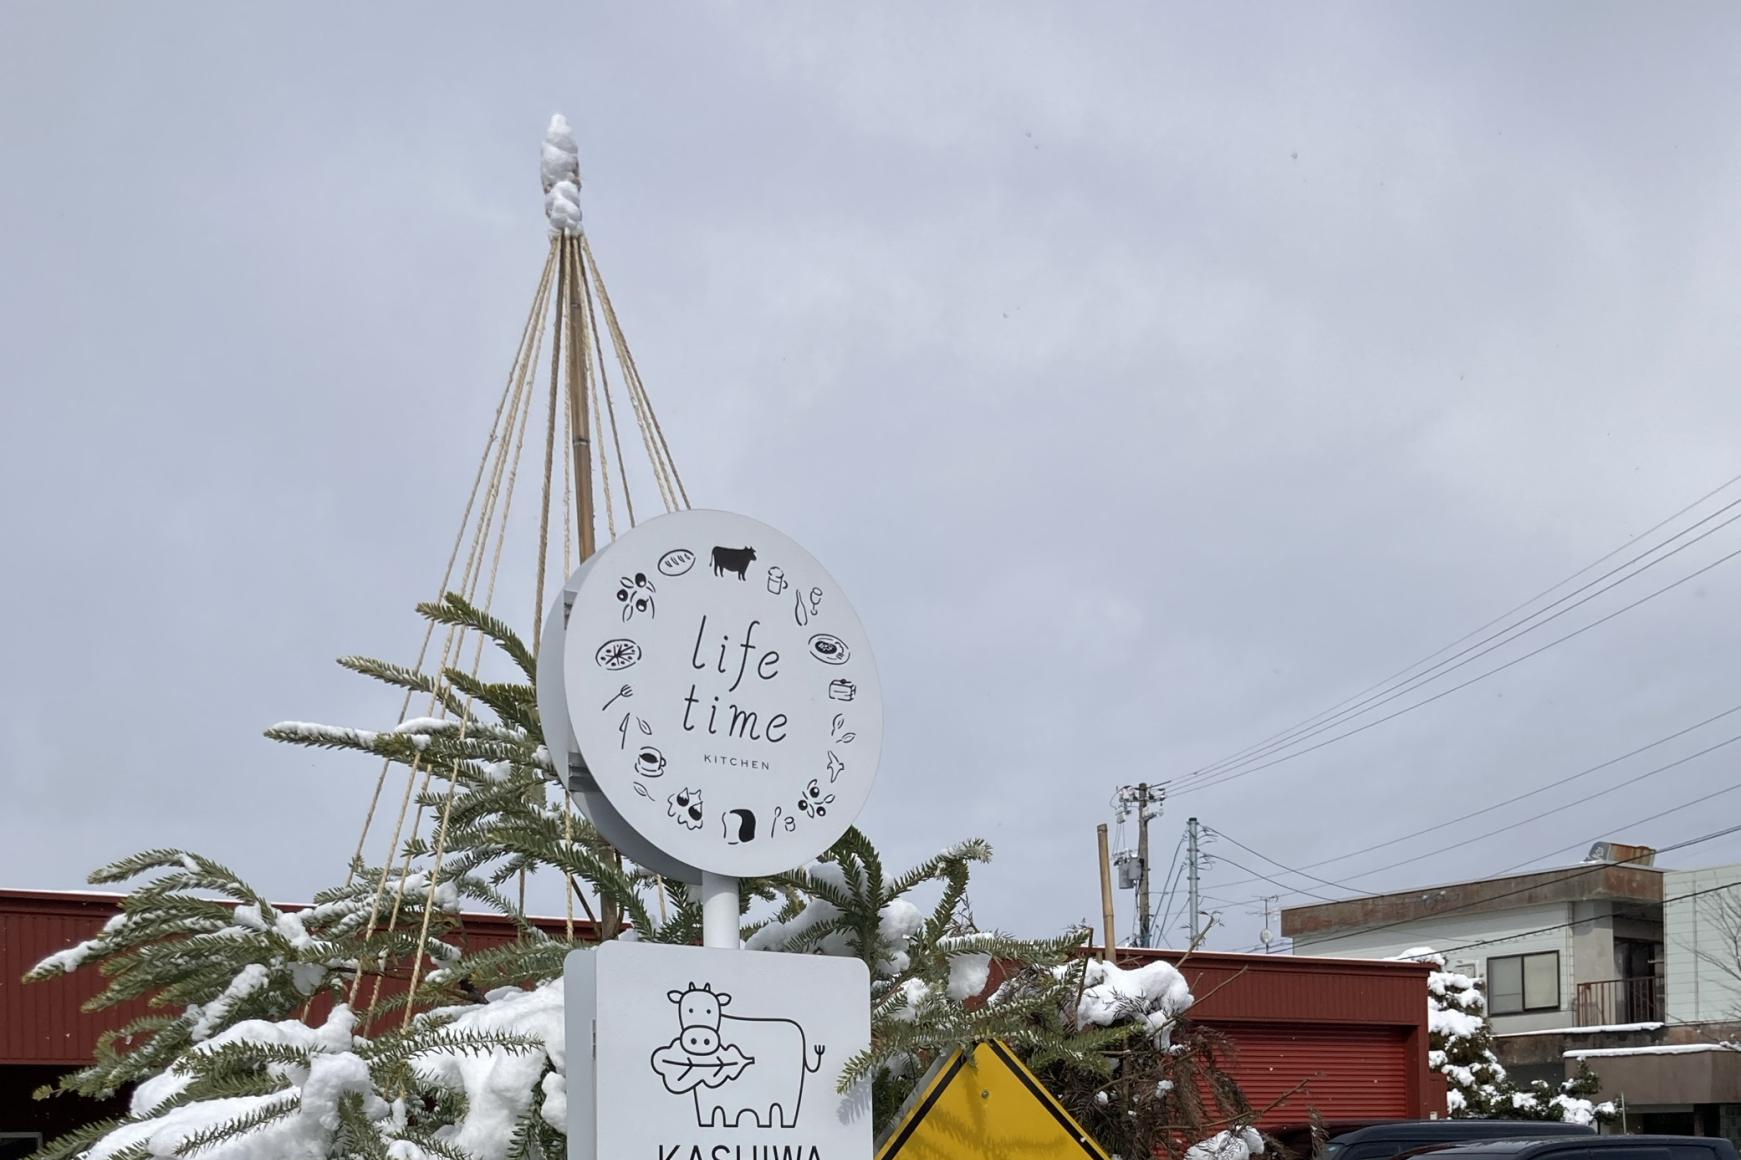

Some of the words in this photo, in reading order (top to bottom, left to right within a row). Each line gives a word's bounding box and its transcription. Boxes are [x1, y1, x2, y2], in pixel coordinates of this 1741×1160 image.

[692, 614, 780, 692] life
[682, 684, 788, 743] time
[703, 754, 770, 771] KITCHEN
